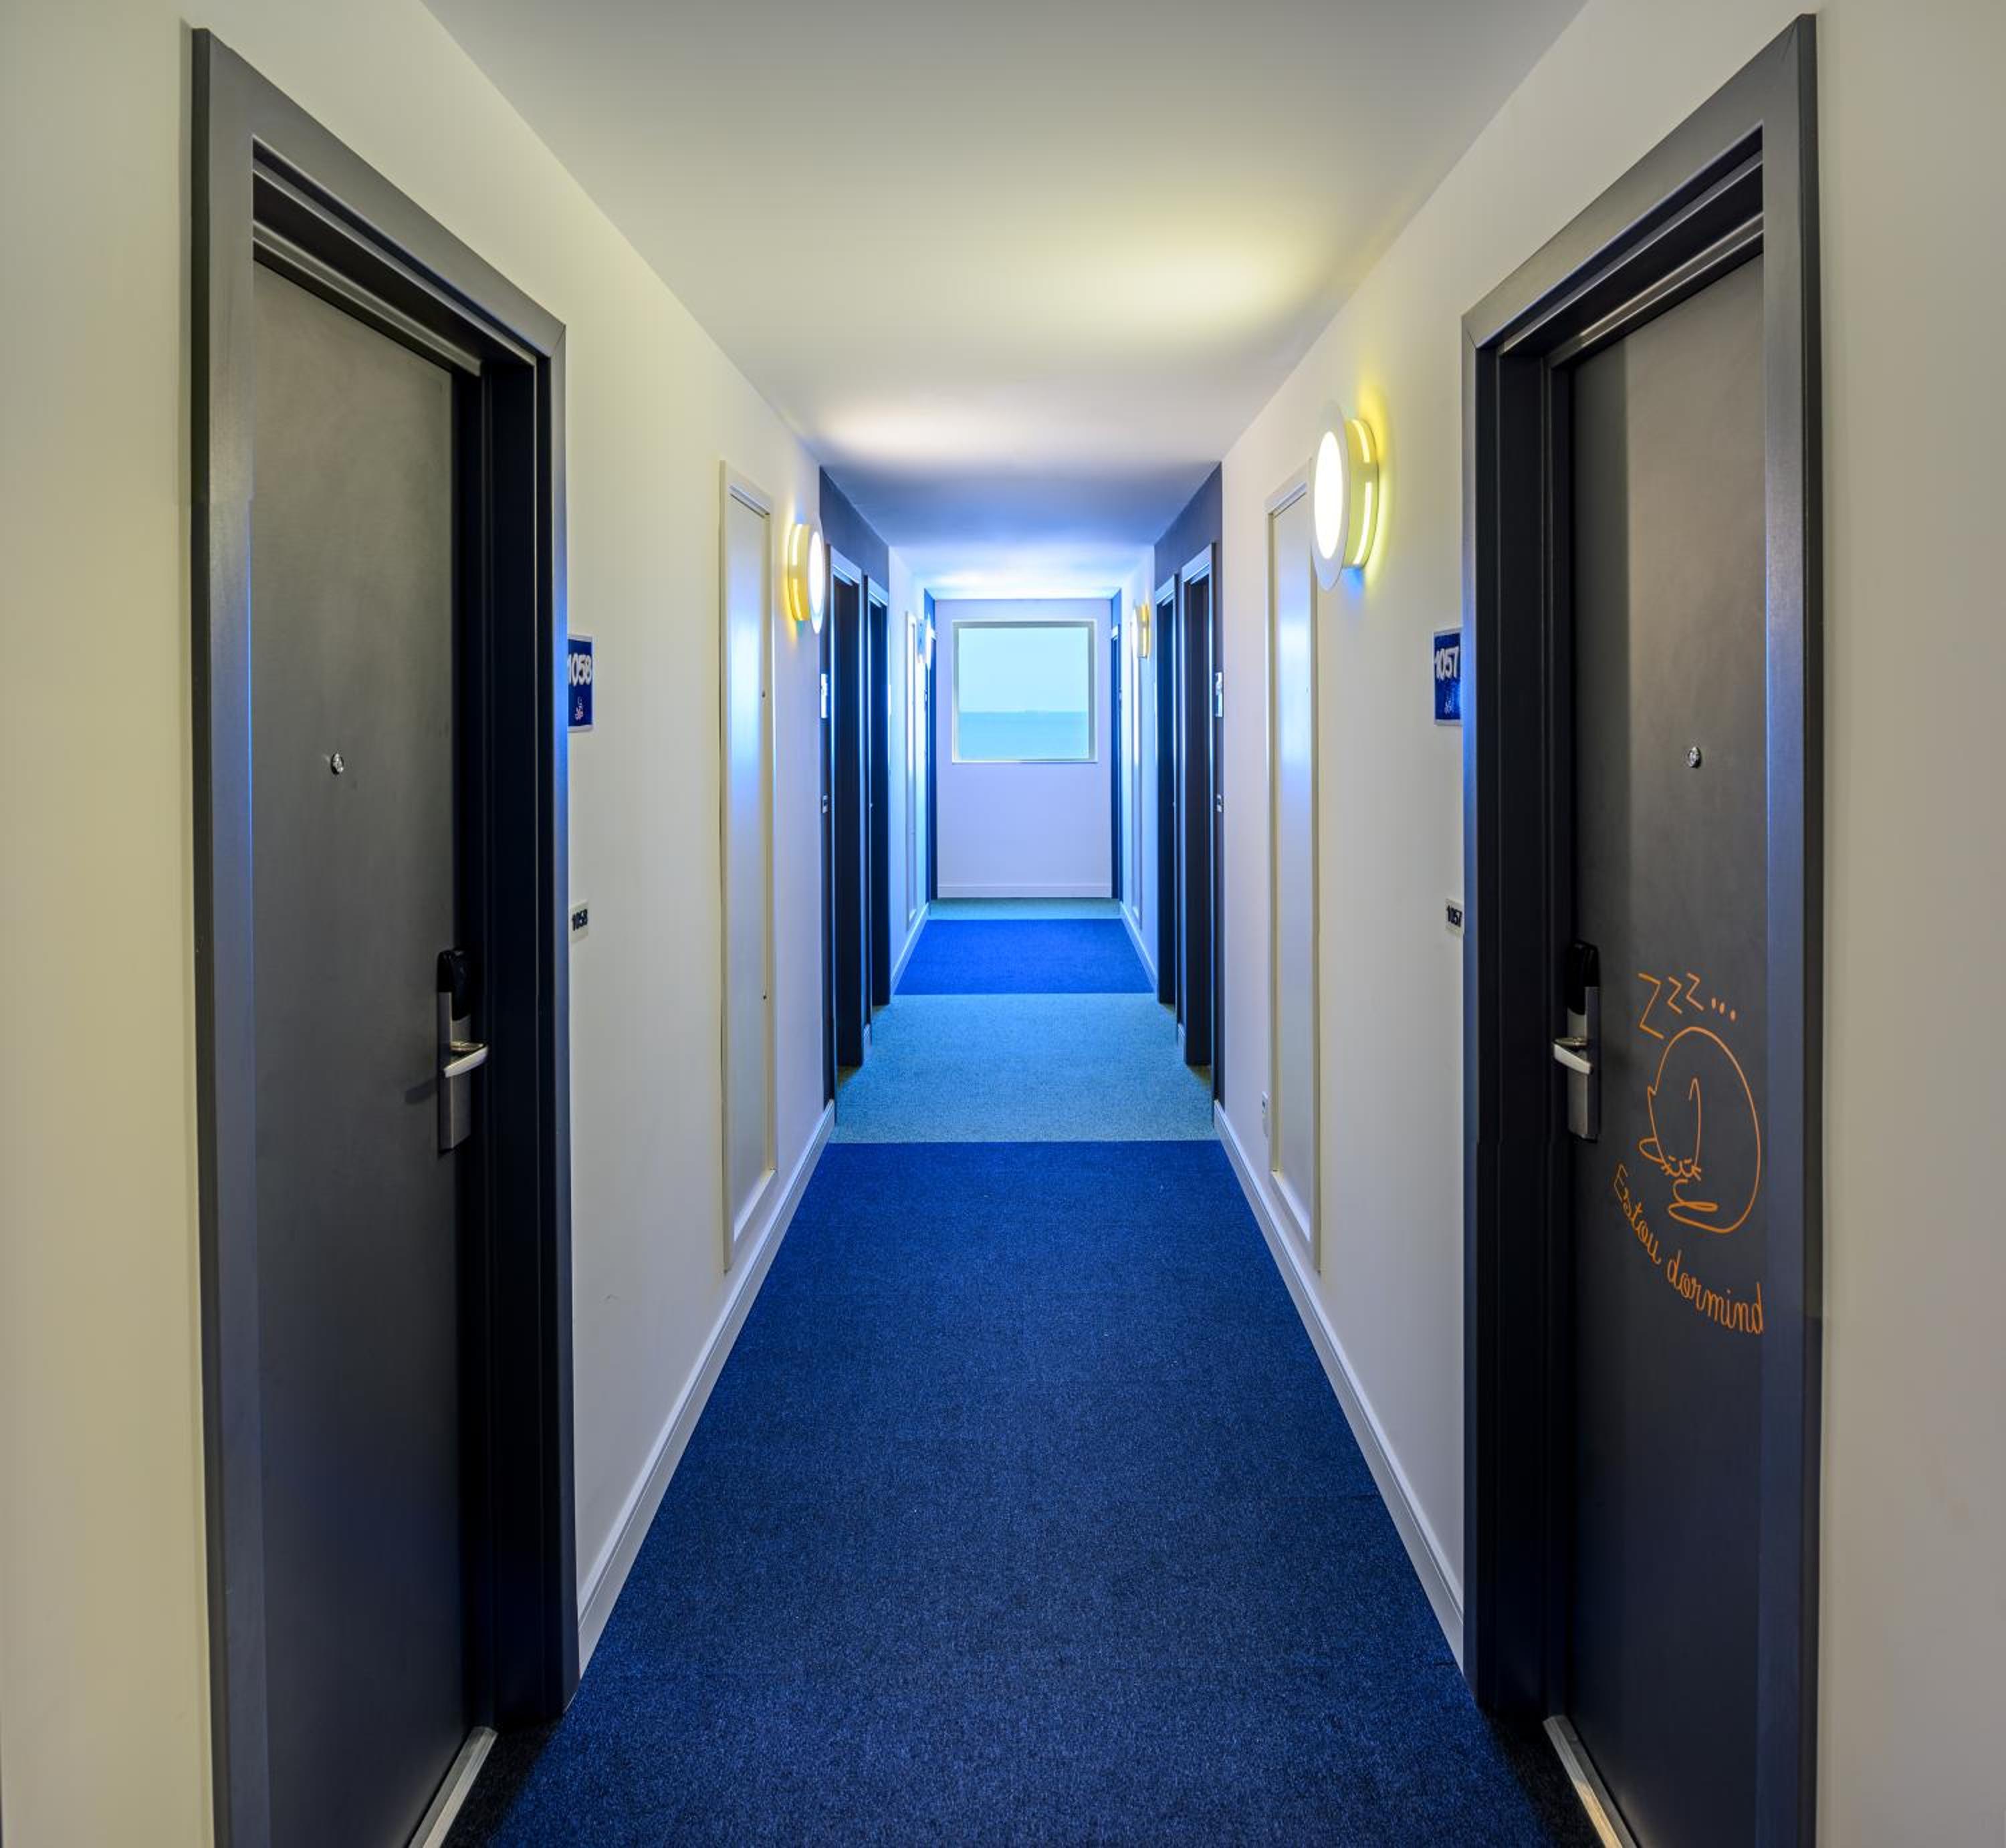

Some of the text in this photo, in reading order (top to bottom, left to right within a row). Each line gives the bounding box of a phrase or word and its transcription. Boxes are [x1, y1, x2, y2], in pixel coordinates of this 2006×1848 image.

[567, 653, 592, 686] 1058
[1435, 646, 1458, 681] 1057
[1666, 1249, 1764, 1335] dormind
